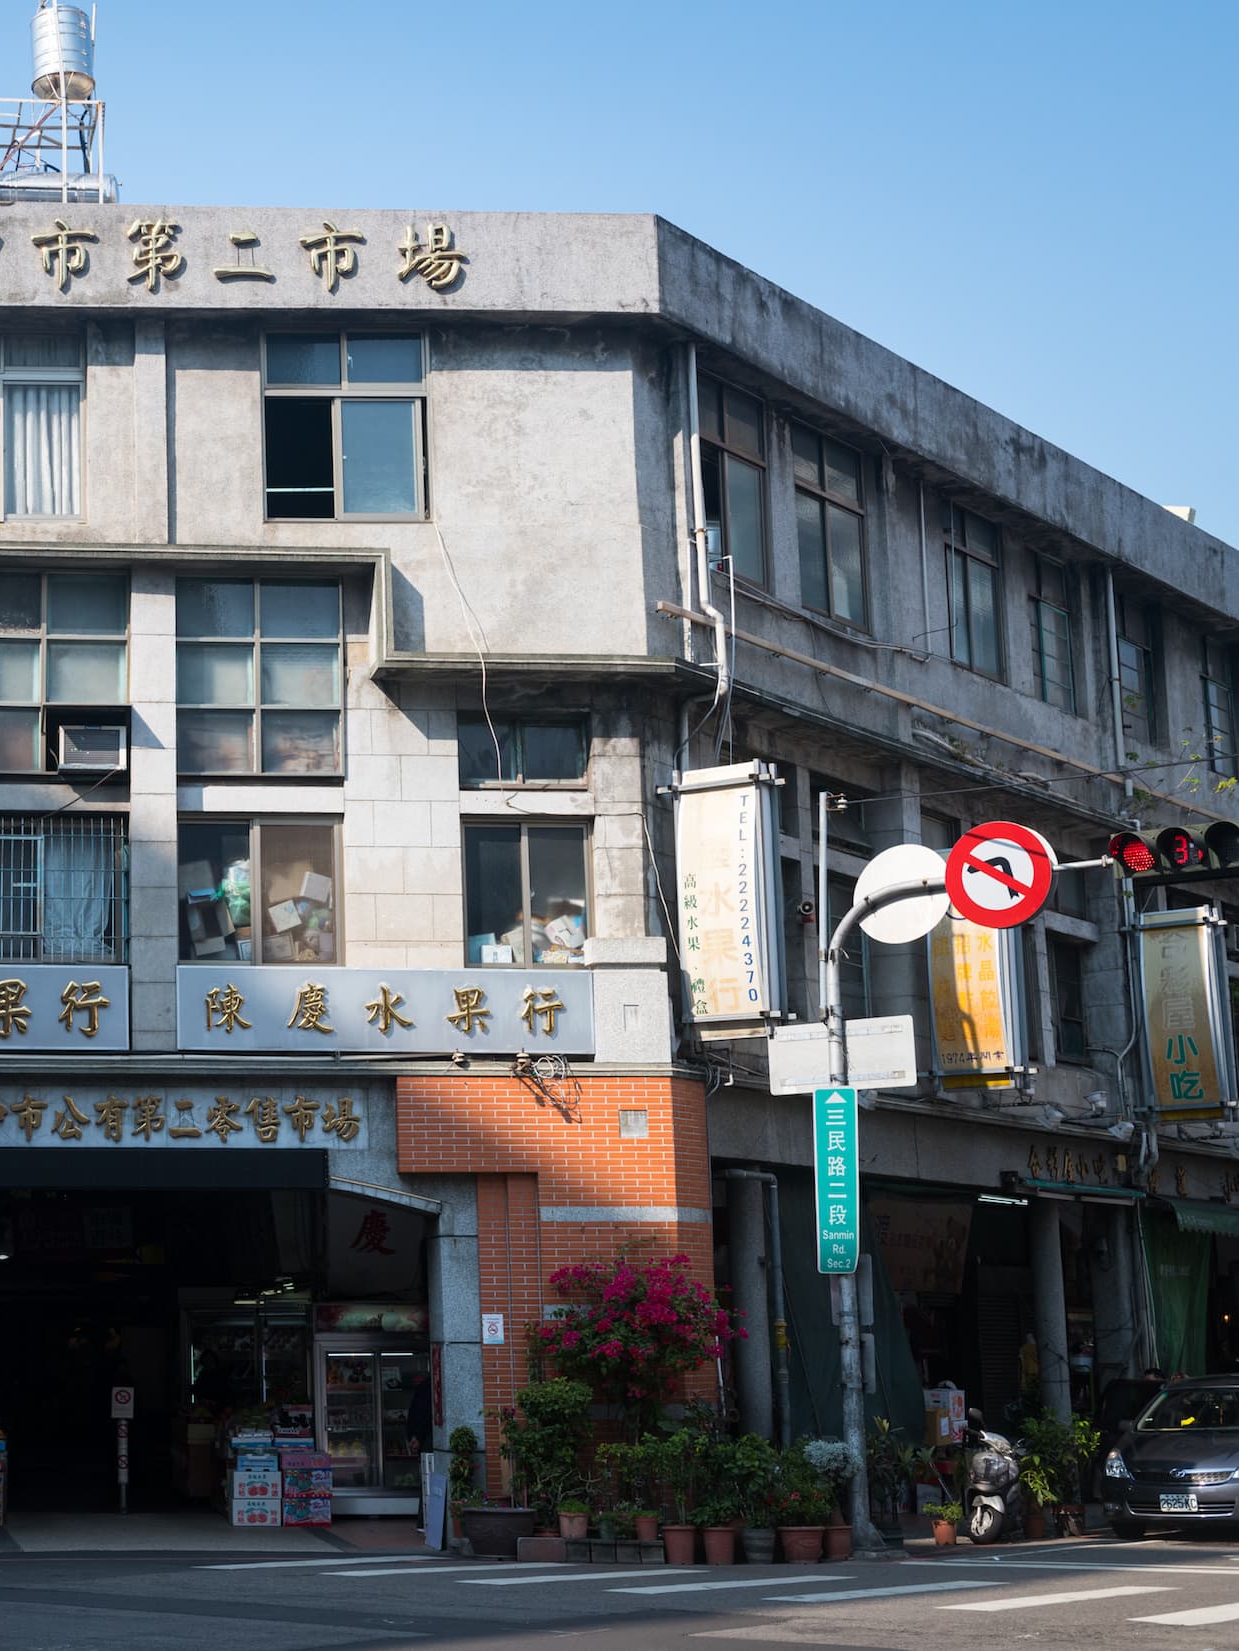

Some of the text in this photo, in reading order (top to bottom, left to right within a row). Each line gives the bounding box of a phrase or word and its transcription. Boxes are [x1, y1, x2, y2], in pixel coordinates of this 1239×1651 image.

[204, 982, 566, 1036] 陳慶水果行
[825, 1109, 848, 1226] 三民路二段
[349, 1208, 396, 1256] 慶
[822, 1229, 855, 1240] Sanmin
[826, 1258, 852, 1269] Sec.2
[832, 1243, 847, 1255] Rd.
